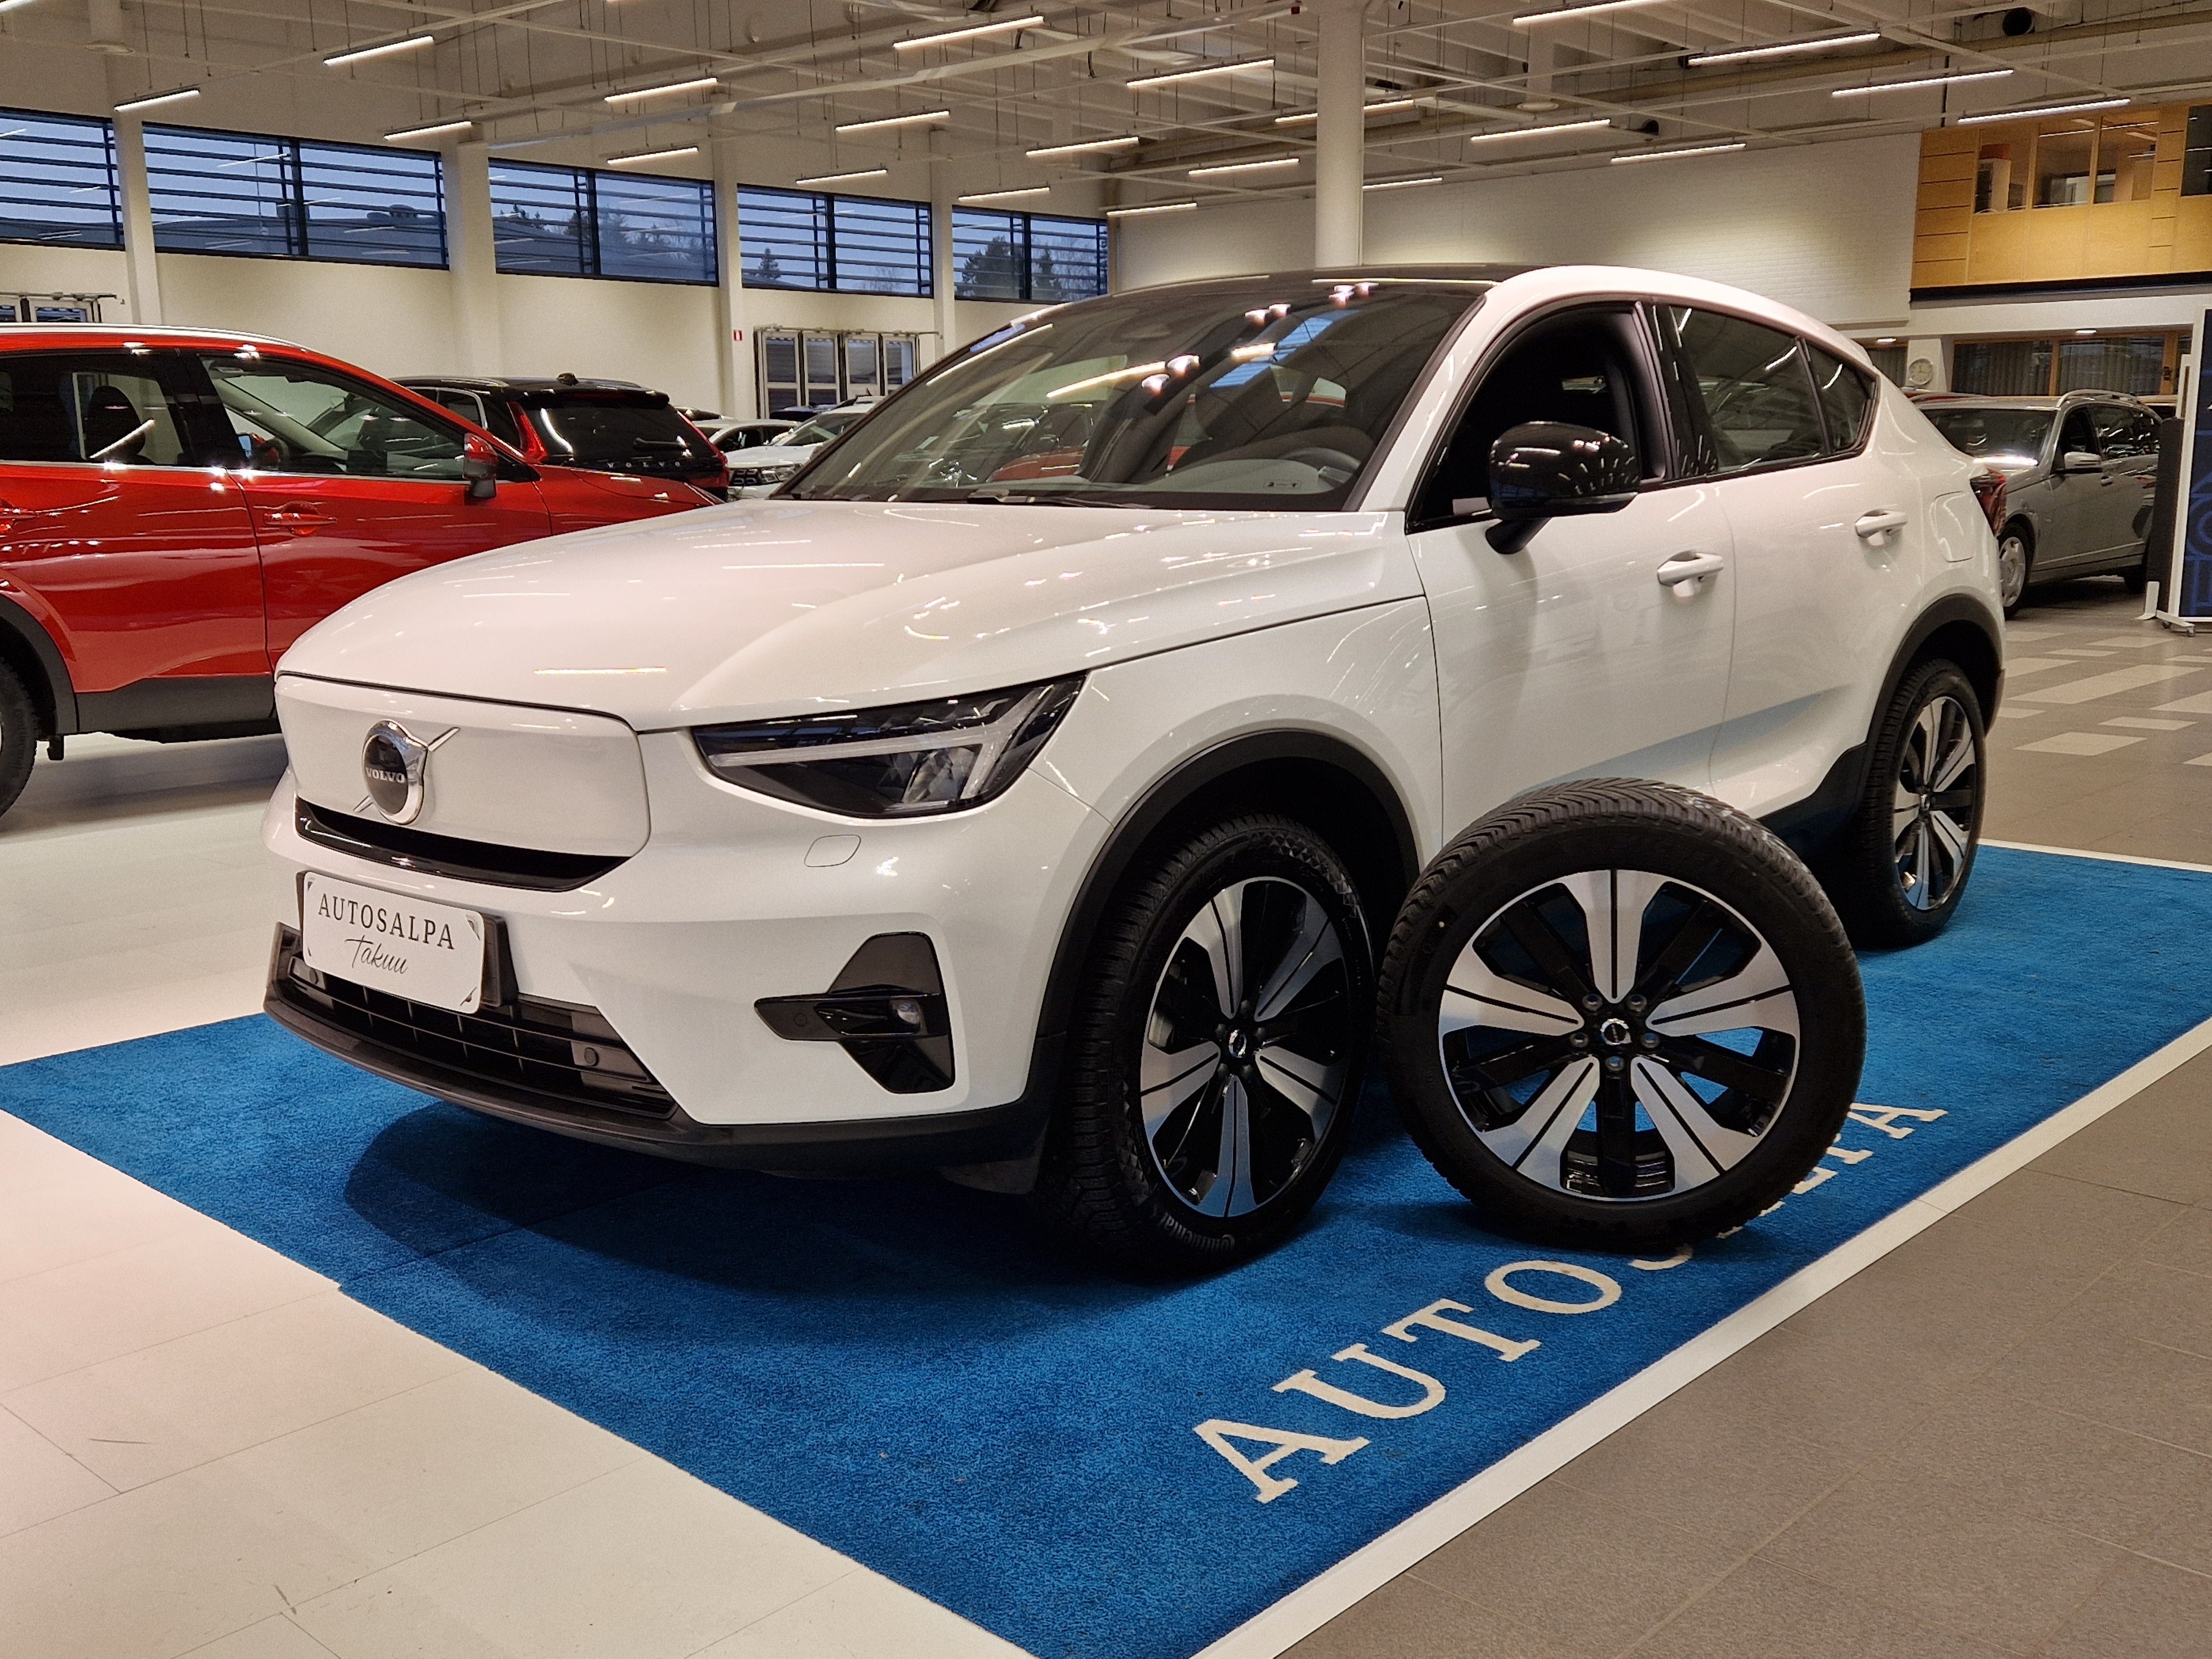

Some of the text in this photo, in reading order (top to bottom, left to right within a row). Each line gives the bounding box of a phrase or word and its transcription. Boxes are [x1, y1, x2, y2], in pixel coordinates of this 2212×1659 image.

[365, 767, 405, 783] VOLVO
[318, 893, 455, 950] AUTOSALPA
[345, 935, 408, 975] Takuu
